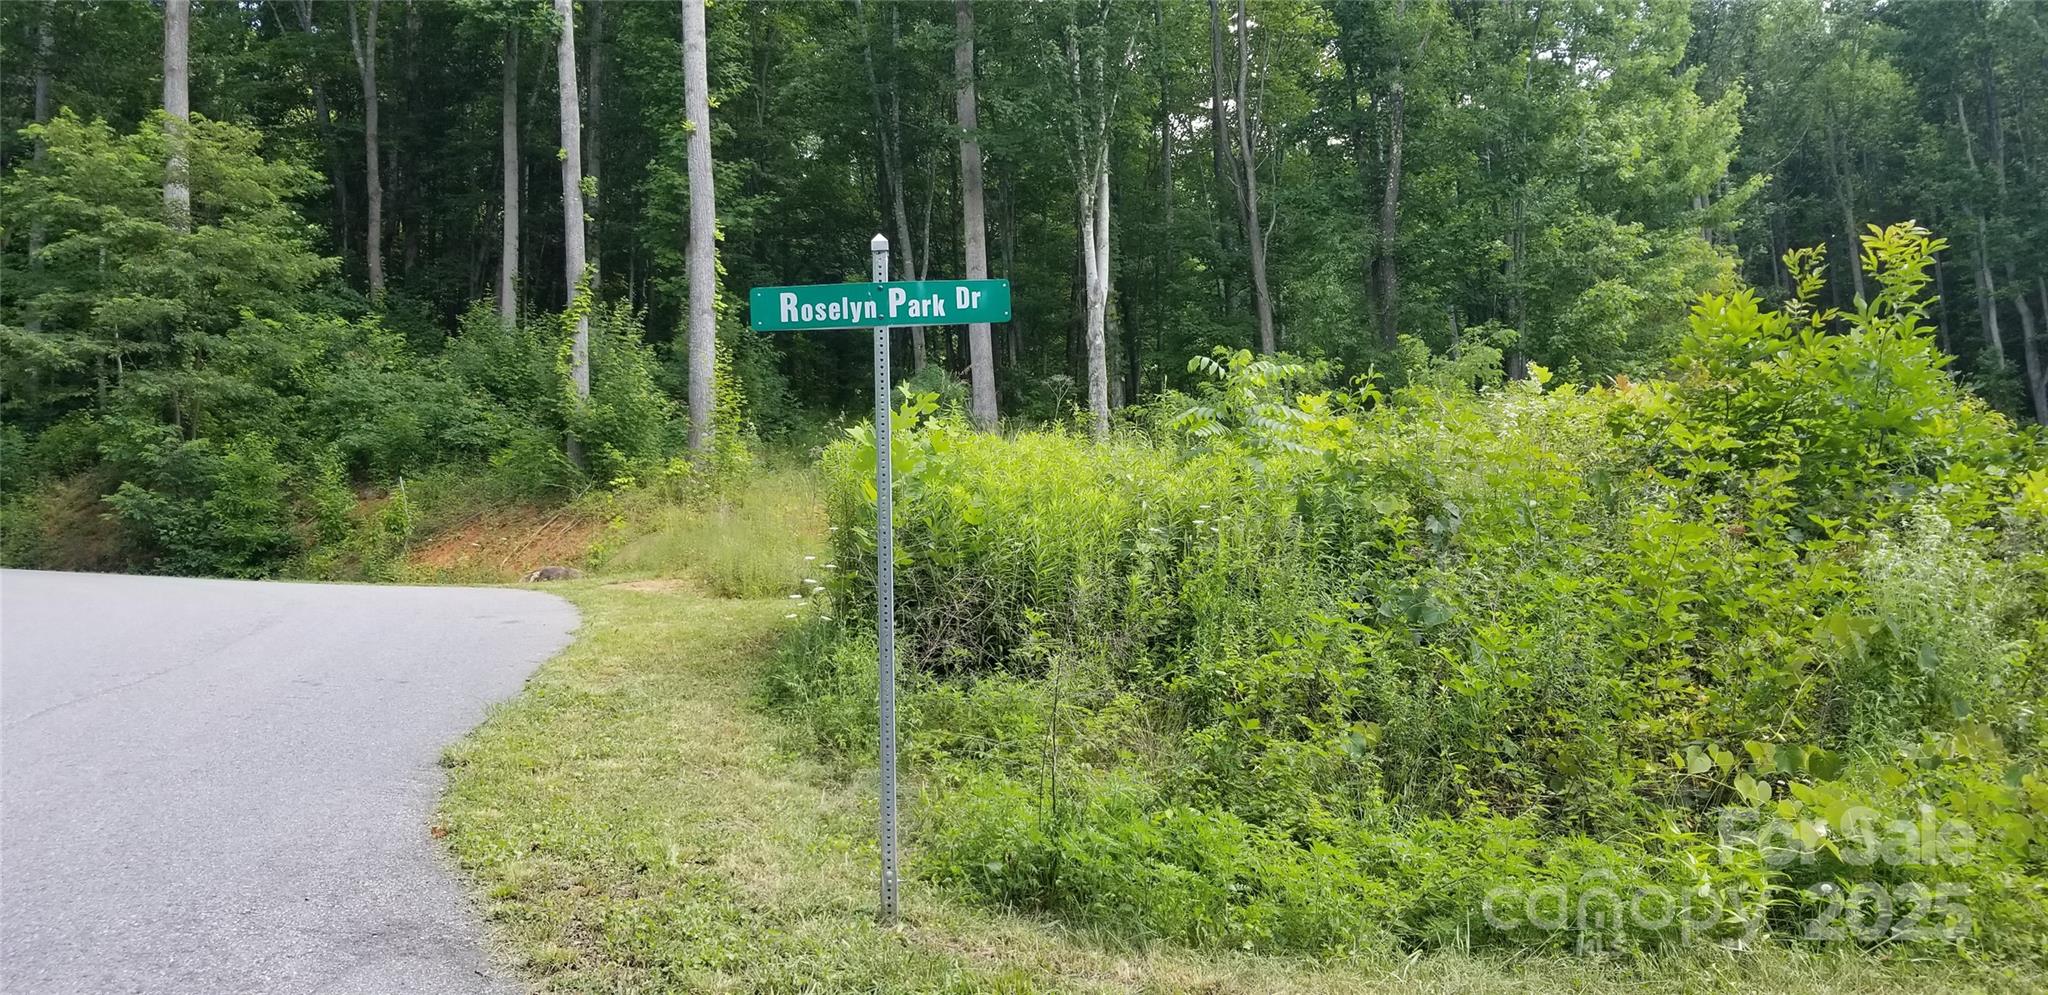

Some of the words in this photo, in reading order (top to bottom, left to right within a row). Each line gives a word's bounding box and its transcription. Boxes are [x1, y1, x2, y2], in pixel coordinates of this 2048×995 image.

[780, 292, 877, 323] Roselyn
[888, 288, 946, 318] Park
[956, 286, 982, 309] Dr
